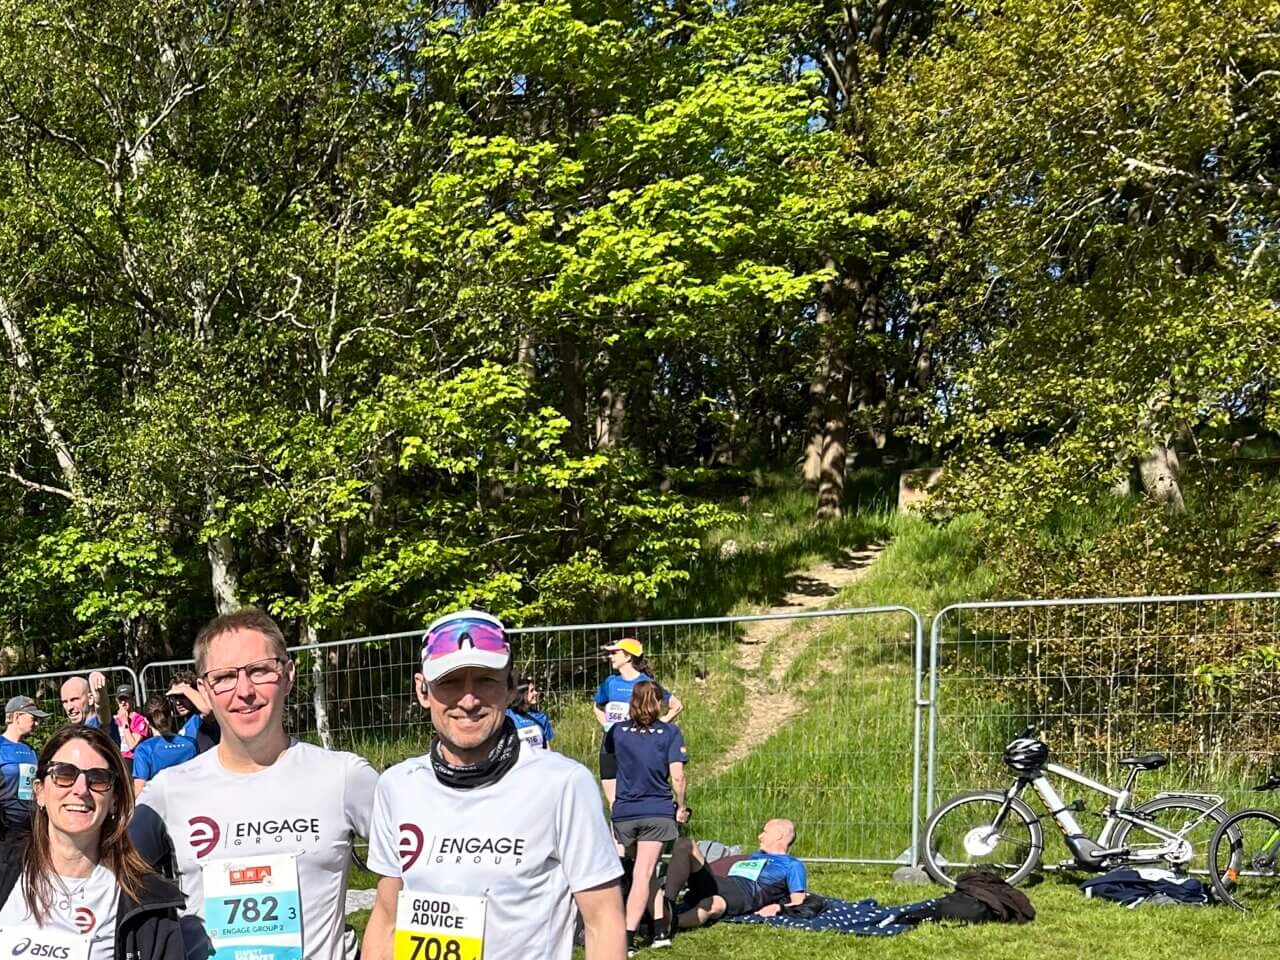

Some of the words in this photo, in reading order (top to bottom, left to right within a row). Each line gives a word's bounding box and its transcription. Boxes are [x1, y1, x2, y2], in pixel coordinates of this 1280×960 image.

[235, 818, 320, 837] ENGAGE
[233, 834, 320, 846] GROUP
[439, 837, 526, 856] ENGAGE
[435, 855, 523, 867] GROUP
[223, 895, 279, 925] 782
[287, 907, 297, 920] 3
[412, 899, 451, 914] GOOD
[410, 912, 465, 929] ADVICE
[222, 926, 252, 936] ENGAGE
[252, 925, 279, 934] GROUP
[30, 942, 71, 960] asics
